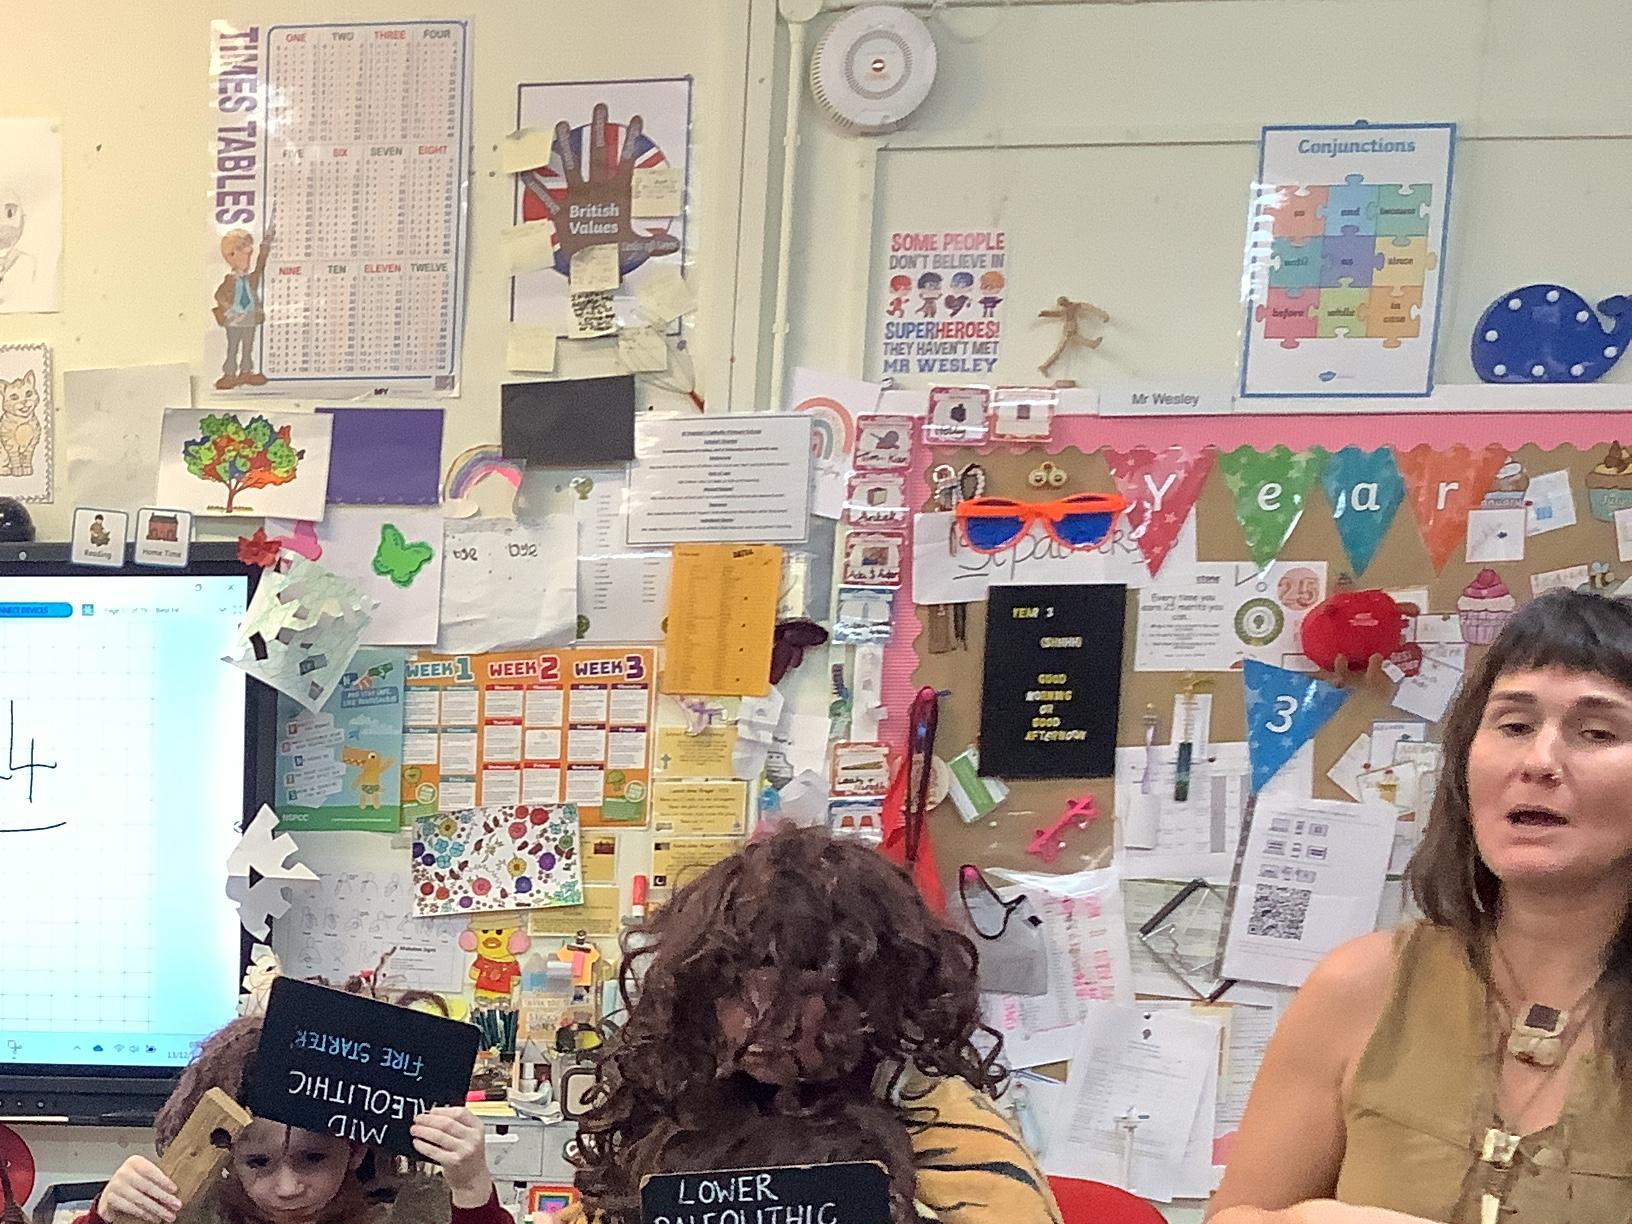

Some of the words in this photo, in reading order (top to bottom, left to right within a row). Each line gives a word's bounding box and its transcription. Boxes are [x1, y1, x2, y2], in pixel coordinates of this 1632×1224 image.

[285, 33, 306, 43] ONE
[331, 31, 354, 41] TWO
[374, 30, 406, 40] THREE
[423, 29, 450, 39] FOUR
[218, 27, 259, 113] TIMES
[283, 149, 304, 158] FIVE
[333, 148, 348, 157] SIX
[370, 147, 403, 156] SEVEN
[418, 145, 447, 155] EIGHT
[1298, 139, 1416, 158] Conjunctions
[216, 121, 257, 224] TABLES
[569, 203, 618, 218] British
[1340, 206, 1360, 216] and
[570, 220, 618, 235] Values
[891, 233, 937, 252] SOME
[943, 232, 1005, 251] PEOPLE
[889, 254, 929, 270] DON'T
[933, 254, 987, 270] BELIEVE
[991, 253, 1005, 268] IN
[279, 266, 302, 276] NINE
[328, 265, 347, 275] TEN
[364, 264, 401, 274] ELEVEN
[410, 263, 448, 273] TWELVE
[1272, 308, 1305, 319] before
[885, 321, 1000, 340] SUPERHEROES!
[883, 341, 914, 355] THEY
[917, 341, 969, 355] HAVEN'T
[972, 341, 999, 355] MET
[883, 358, 911, 373] MR
[918, 358, 998, 373] WESLEY
[1132, 393, 1149, 405] Mr
[1151, 392, 1200, 408] Wesley
[83, 548, 113, 561] Reading
[142, 548, 160, 558] Home
[161, 549, 182, 559] Time
[1151, 593, 1176, 604] Every
[1179, 593, 1196, 602] time
[1200, 594, 1216, 603] you
[1278, 577, 1319, 606] 25
[1012, 607, 1040, 618] YEAR
[1046, 607, 1054, 618] 3
[1208, 604, 1224, 614] you
[405, 663, 454, 678] WEEK
[456, 657, 473, 681] 1
[490, 661, 537, 677] WEEK
[540, 656, 559, 681] 2
[575, 661, 623, 676] WEEK
[625, 655, 645, 680] 3
[1038, 673, 1067, 684] GOOD
[1025, 690, 1073, 702] MORNING
[1039, 704, 1054, 714] OR
[1265, 695, 1299, 734] 3
[1031, 717, 1061, 728] GOOD
[288, 1070, 440, 1124] ALEOLITHIC
[327, 1114, 389, 1145] MID
[677, 1173, 779, 1205] LOWER
